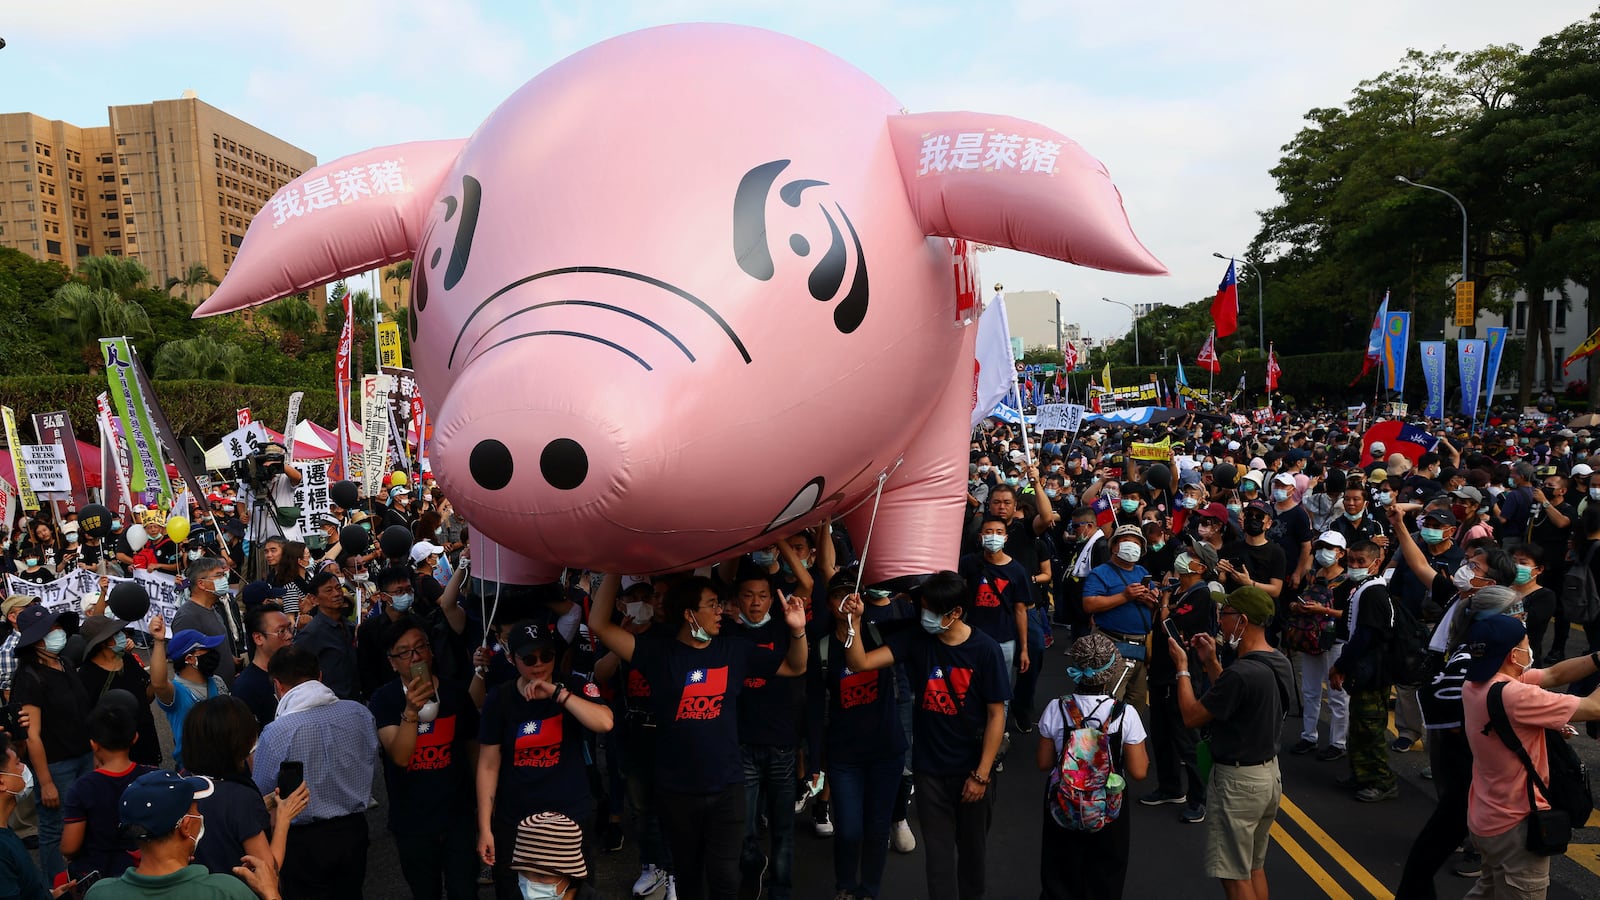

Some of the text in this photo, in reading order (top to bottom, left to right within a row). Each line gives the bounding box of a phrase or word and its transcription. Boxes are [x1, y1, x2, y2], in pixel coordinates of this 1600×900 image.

[919, 133, 1061, 176] 我是萊豬
[272, 160, 405, 226] 我是萊豬
[42, 480, 55, 488] NOW
[678, 695, 724, 712] ROC
[675, 709, 721, 722] FOREVER
[409, 744, 451, 763] ROC
[514, 745, 560, 760] ROC
[514, 757, 559, 768] FOREVER
